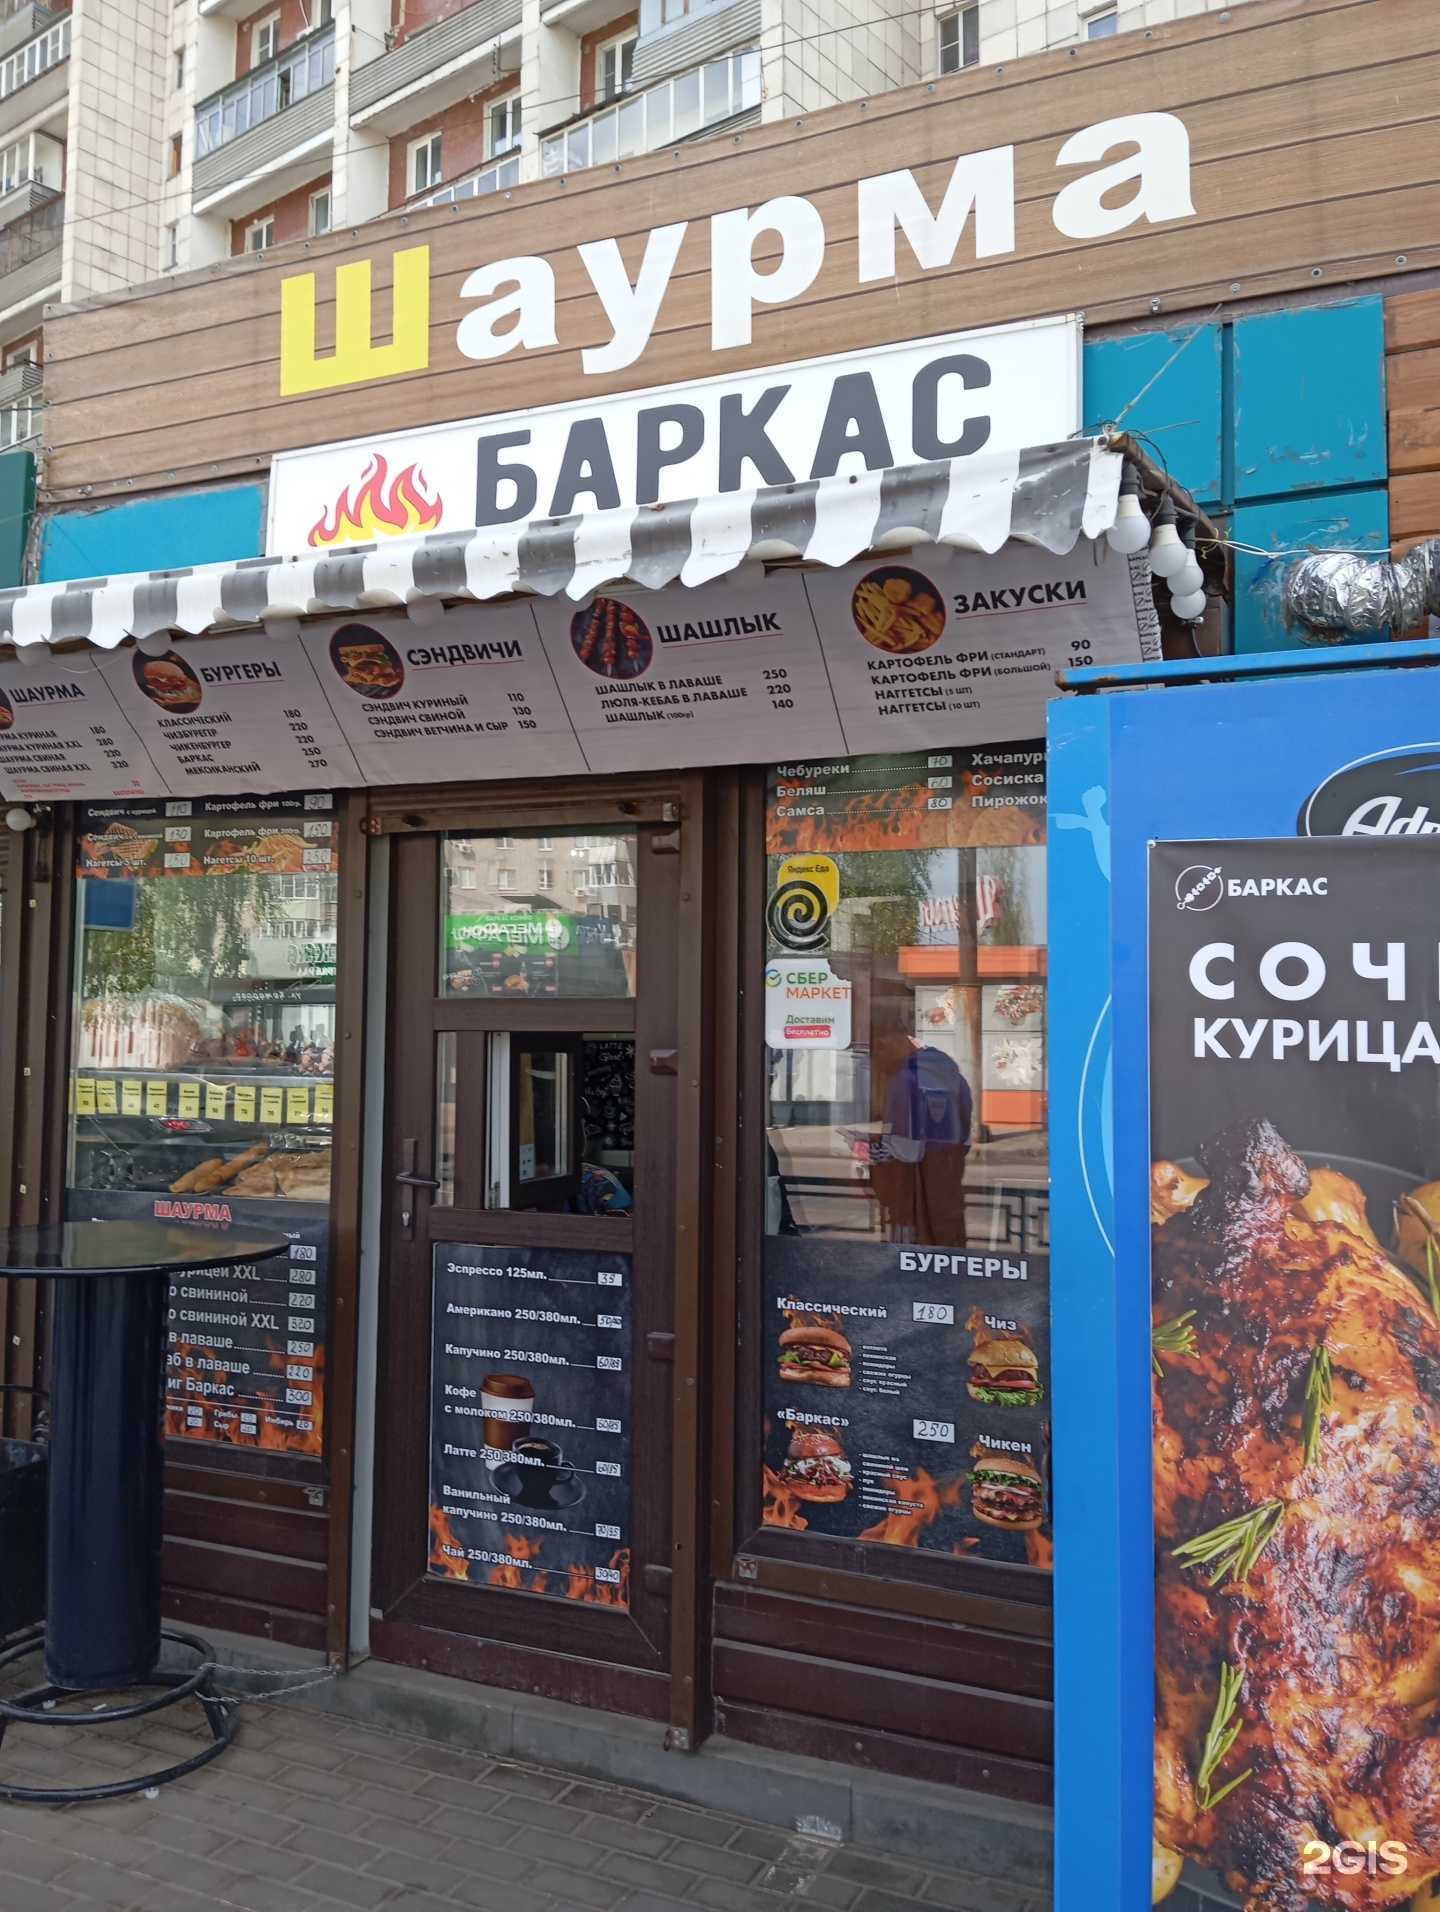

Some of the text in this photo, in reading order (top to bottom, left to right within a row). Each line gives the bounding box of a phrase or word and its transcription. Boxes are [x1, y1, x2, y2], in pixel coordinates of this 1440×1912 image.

[475, 353, 992, 525] БАРКАС
[953, 579, 1087, 614] ЗАКУСКИ
[656, 612, 781, 643] ШАШЛЫК
[407, 640, 523, 666] СЭНДВИЧИ
[867, 639, 1091, 671] КАРТОФЕЛЬ ФРИ (СТАНДАРТ) 90
[200, 661, 282, 682] БУРГЕРЫ
[871, 655, 1094, 686] КАРТОФЕЛЬ ФРИ (БОЛЬШОЙ) 150
[595, 668, 787, 696] ШАШЛЫК В ЛАВАШЕ 250
[9, 683, 85, 703] ШАУРМА
[362, 692, 525, 713] СЭНДВИЧ КУРИНЫЙ 110
[601, 683, 792, 709] ЛЮЛЯ-КЕБАБ В ЛАВАШЕ 220
[875, 686, 943, 700] НАГГЕТСЫ
[368, 706, 532, 727] СЭНДВИЧ СВИНОЙ 130
[606, 710, 665, 723] ШАШЛЫК
[771, 699, 794, 710] 140
[878, 701, 947, 716] НАГГЕТСЫ
[157, 712, 232, 728] КЛАССИЧЕСКИЙ
[374, 719, 537, 739] СЭНДВИЧ ВЕТЧИНА И СЫР 150
[17, 730, 58, 740] КУРИНАЯ
[24, 742, 65, 752] КУРИНАЯ
[64, 741, 83, 749] XXL
[170, 741, 232, 752] ЧИКЕНБУРГЕР
[177, 747, 321, 764] БАРКАС 250
[32, 753, 67, 762] СВИНАЯ
[185, 759, 328, 776] МЕКСИКАНСКИЙ 270
[972, 752, 1048, 766] Хачапур
[4, 766, 40, 775] ШАУРМА
[39, 765, 73, 773] СВИНАЯ
[776, 764, 850, 779] Чебуреки
[972, 773, 1044, 787] Сосиска
[776, 785, 826, 798] Беляш
[204, 799, 280, 813] Картофель фри
[776, 806, 824, 818] Самса
[972, 795, 1047, 810] Пирожок
[204, 828, 257, 840] Картофель
[258, 826, 280, 837] фри
[1227, 877, 1328, 897] БАРКАС
[786, 973, 828, 985] СБЕР
[1188, 942, 1440, 1001] СОЧ
[786, 987, 850, 1000] МАРКЕТ
[786, 1014, 835, 1025] Доставим
[1194, 1017, 1440, 1072] КУРИЦА
[154, 1200, 232, 1222] ШАУРМА
[175, 1266, 229, 1280] урицей
[233, 1265, 261, 1281] XXL
[447, 1262, 503, 1277] Эспрессо
[506, 1266, 547, 1280] 125мл.
[900, 1251, 1028, 1281] БУРГЕРЫ
[180, 1287, 248, 1303] свининой
[291, 1294, 313, 1307] 220
[180, 1308, 247, 1327] свининой
[251, 1313, 279, 1329] XXL
[446, 1303, 512, 1318] Американо
[515, 1308, 581, 1325] 250/380мл.
[776, 1296, 948, 1321] Классический 180
[984, 1315, 1017, 1331] Чиз
[169, 1332, 311, 1354] в лаваше 250
[167, 1352, 181, 1366] аб
[185, 1357, 193, 1367] в
[197, 1359, 250, 1375] лаваше
[445, 1343, 569, 1366] Капучино 250/380мл.
[168, 1377, 182, 1389] иг
[186, 1378, 235, 1397] Баркас
[444, 1384, 477, 1398] Кофе
[455, 1406, 509, 1421] молоком
[510, 1411, 576, 1428] 250/380мл.
[777, 1407, 950, 1438] «Баркас» 250
[978, 1433, 1032, 1454] Чикен
[444, 1443, 477, 1458] Латте
[479, 1449, 545, 1467] 250/380мл.
[443, 1485, 511, 1505] Ванильный
[443, 1506, 567, 1532] капучино 250/380мл.
[442, 1544, 465, 1558] Чай
[467, 1549, 533, 1568] 250/380мл.
